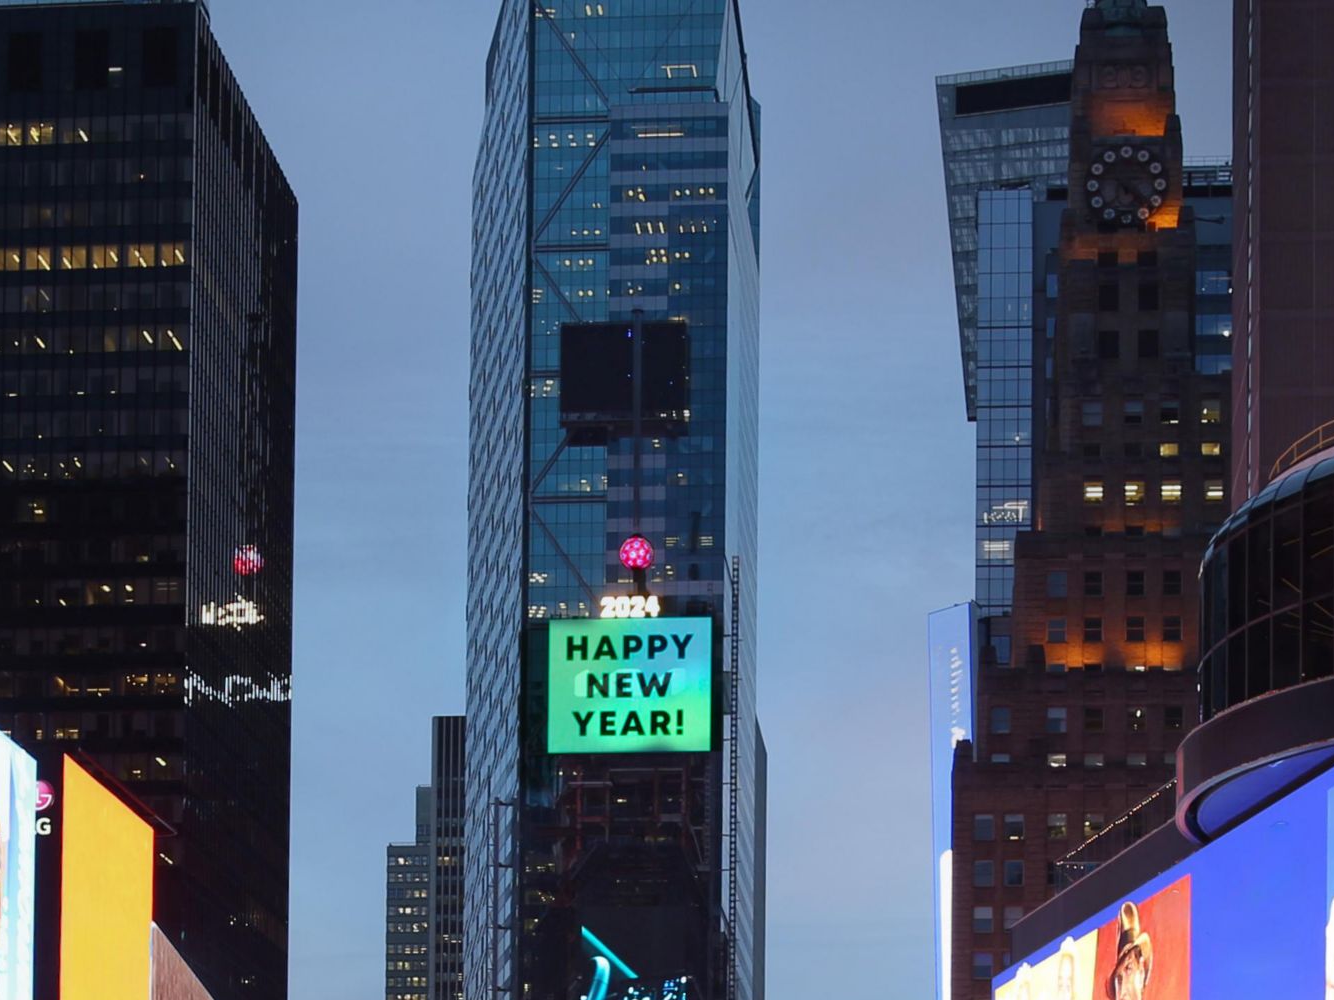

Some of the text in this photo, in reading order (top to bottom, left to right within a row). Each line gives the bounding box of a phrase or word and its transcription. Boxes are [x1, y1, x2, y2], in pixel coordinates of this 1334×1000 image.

[599, 595, 660, 618] 2024
[566, 633, 694, 662] HAPPY
[586, 672, 673, 698] NEW
[572, 709, 684, 736] YEAR!
